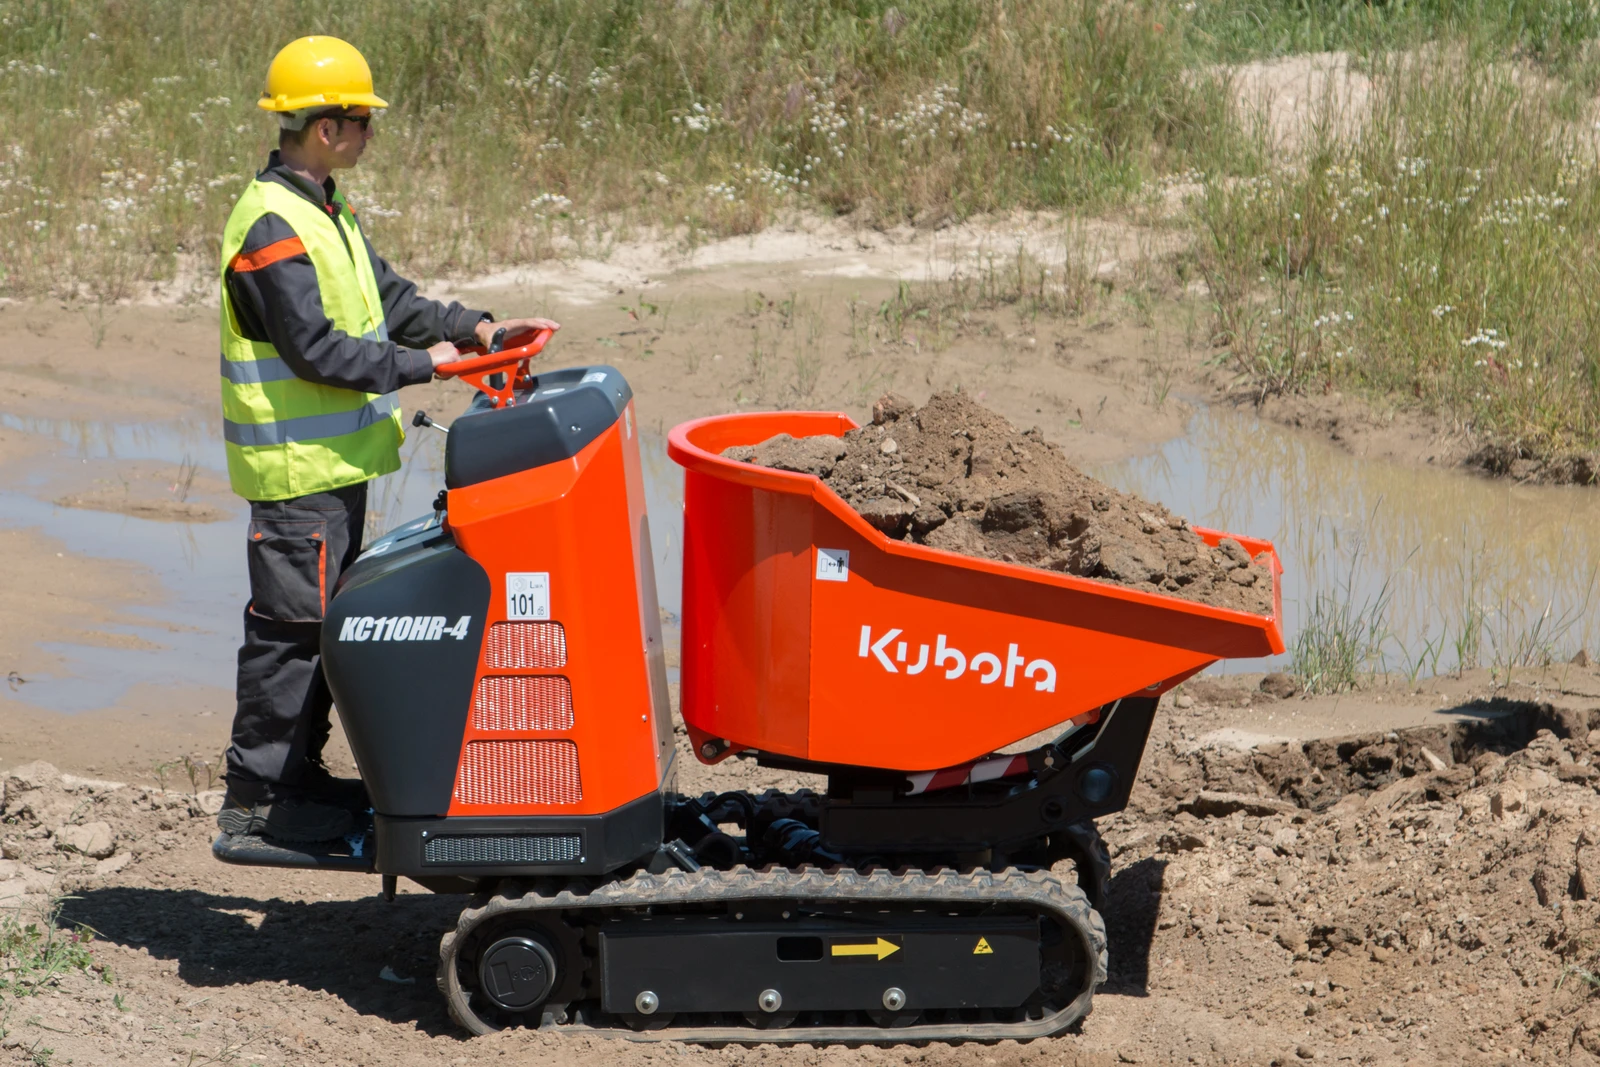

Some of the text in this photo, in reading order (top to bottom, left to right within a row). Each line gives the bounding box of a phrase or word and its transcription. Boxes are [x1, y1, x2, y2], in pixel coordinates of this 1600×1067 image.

[511, 594, 534, 615] 101
[338, 616, 471, 641] KC110HR-4
[858, 625, 1057, 692] Kubota
